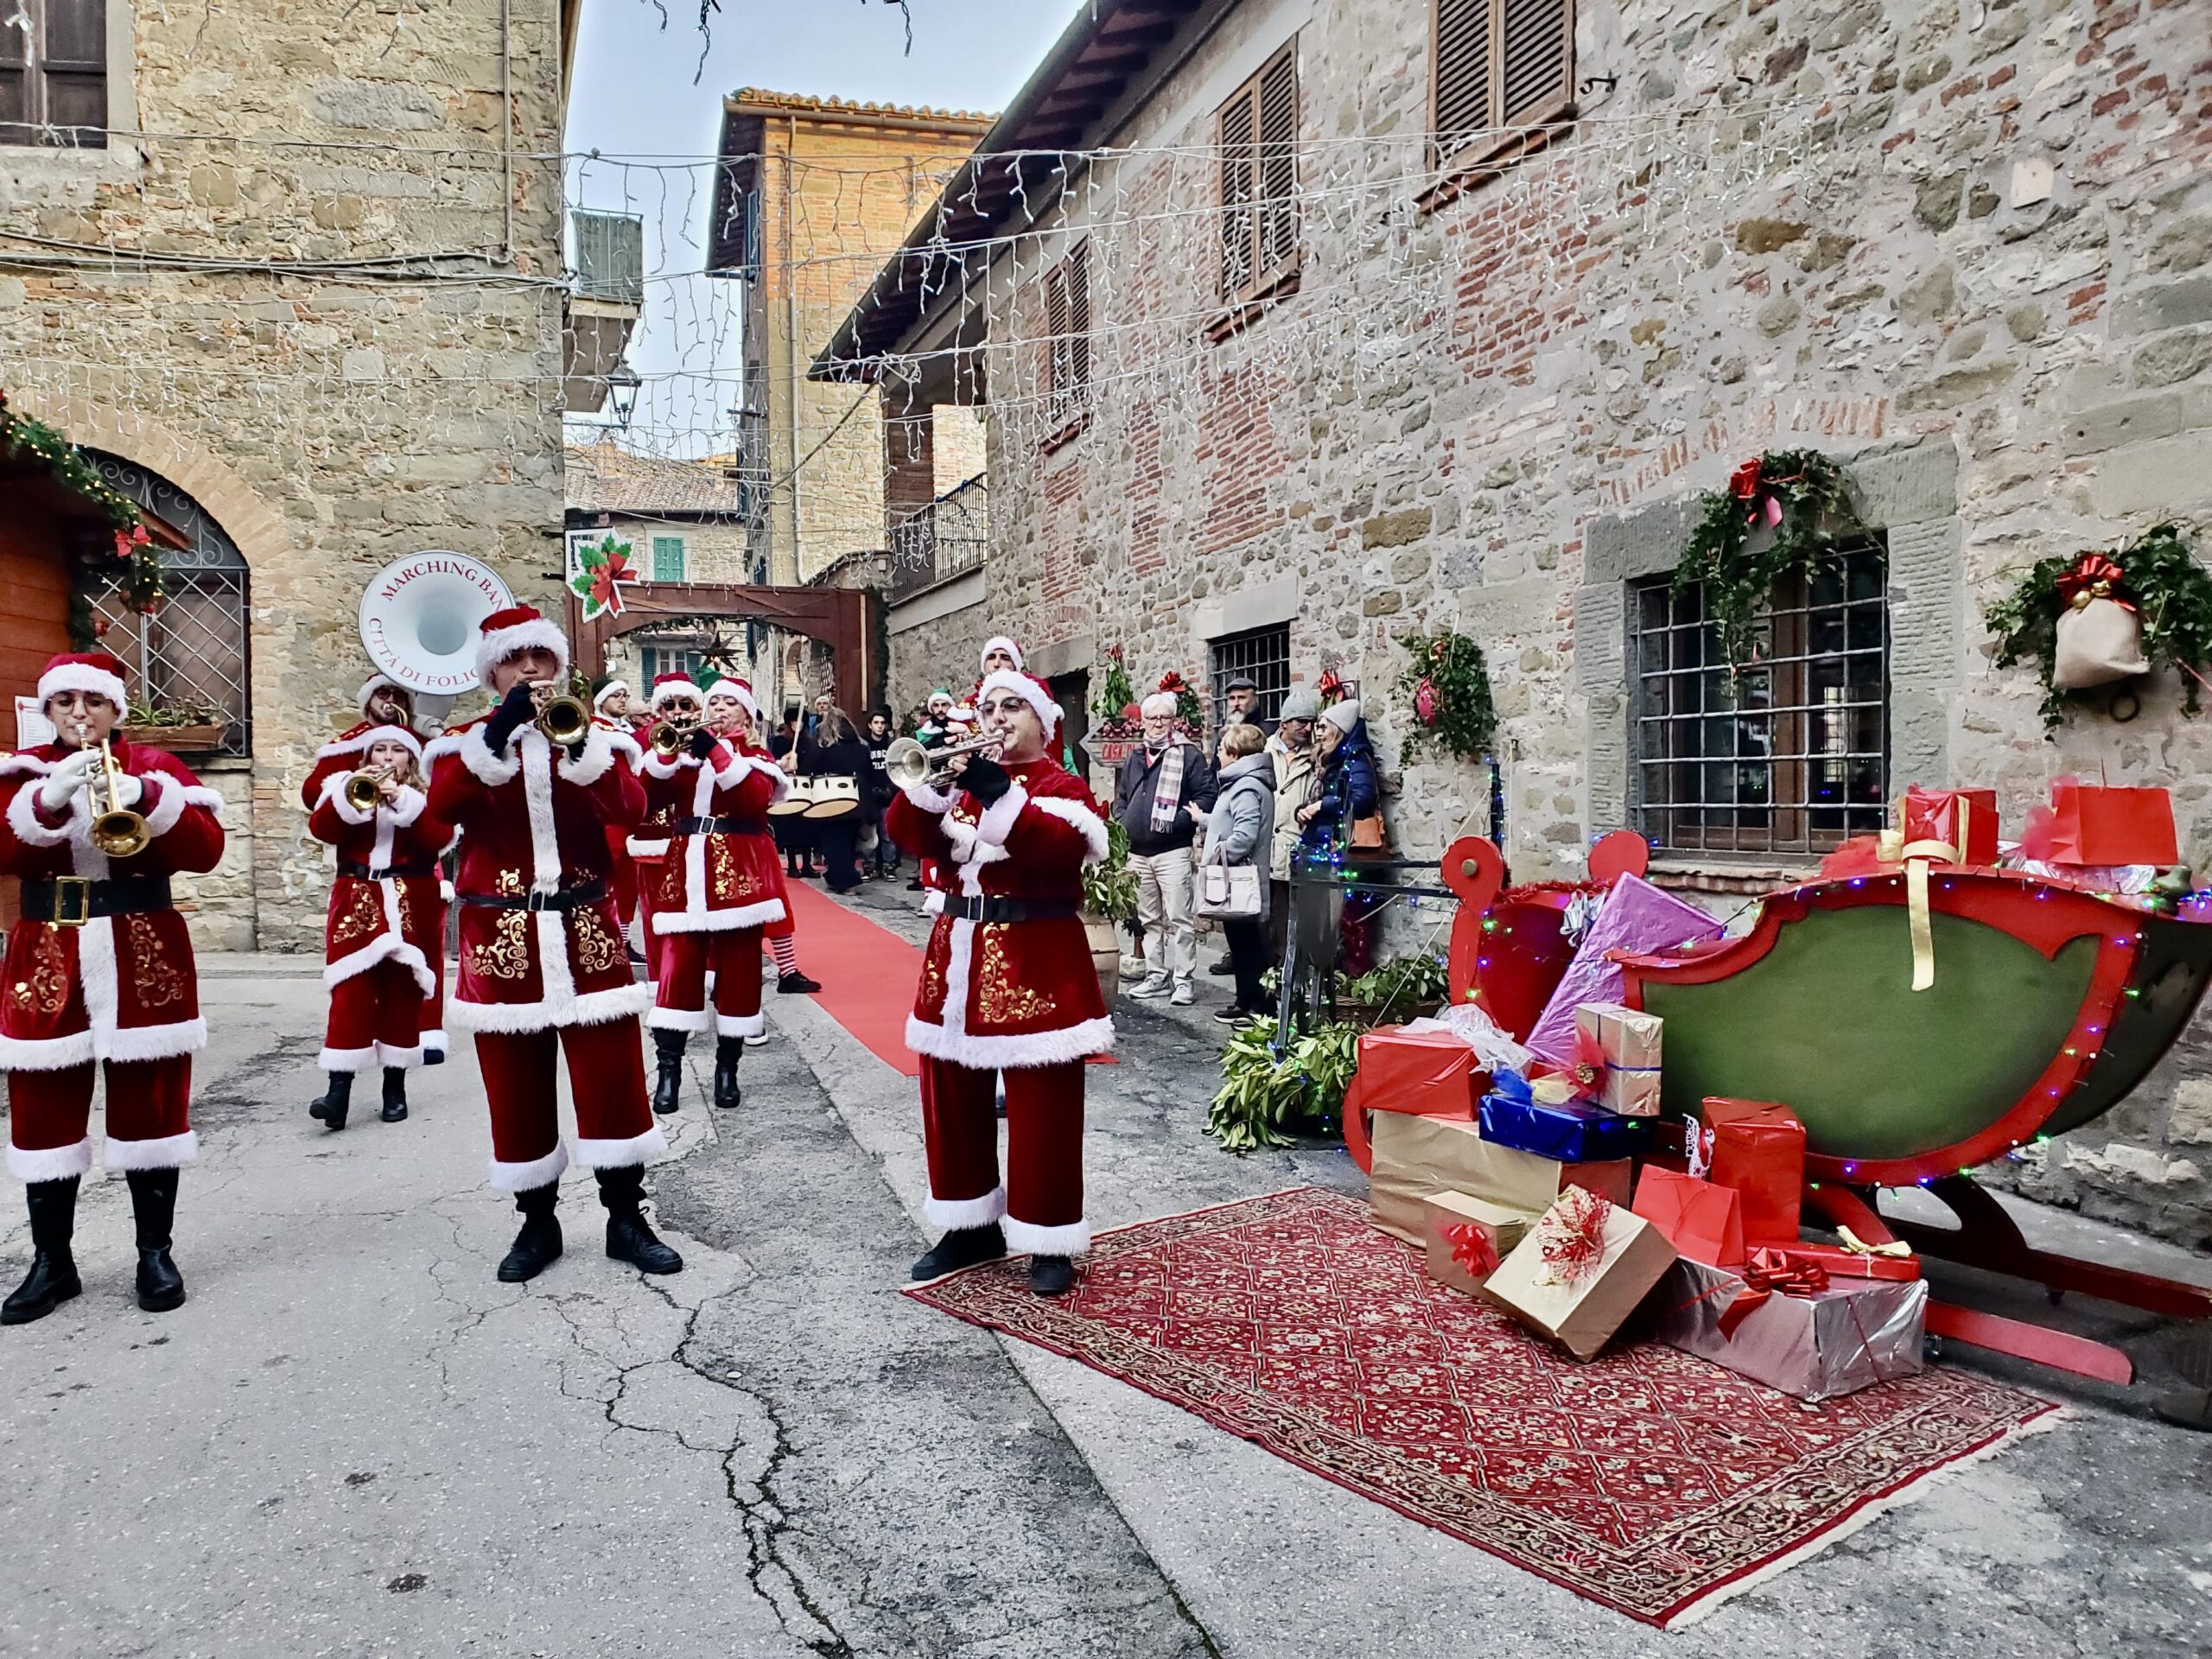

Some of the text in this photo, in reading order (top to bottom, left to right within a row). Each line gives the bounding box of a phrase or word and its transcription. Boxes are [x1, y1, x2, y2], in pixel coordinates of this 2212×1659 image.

[380, 560, 505, 611] MARCHING BAN
[369, 618, 400, 668] CITTÀ
[399, 665, 422, 682] DI
[1102, 743, 1123, 760] CASA
